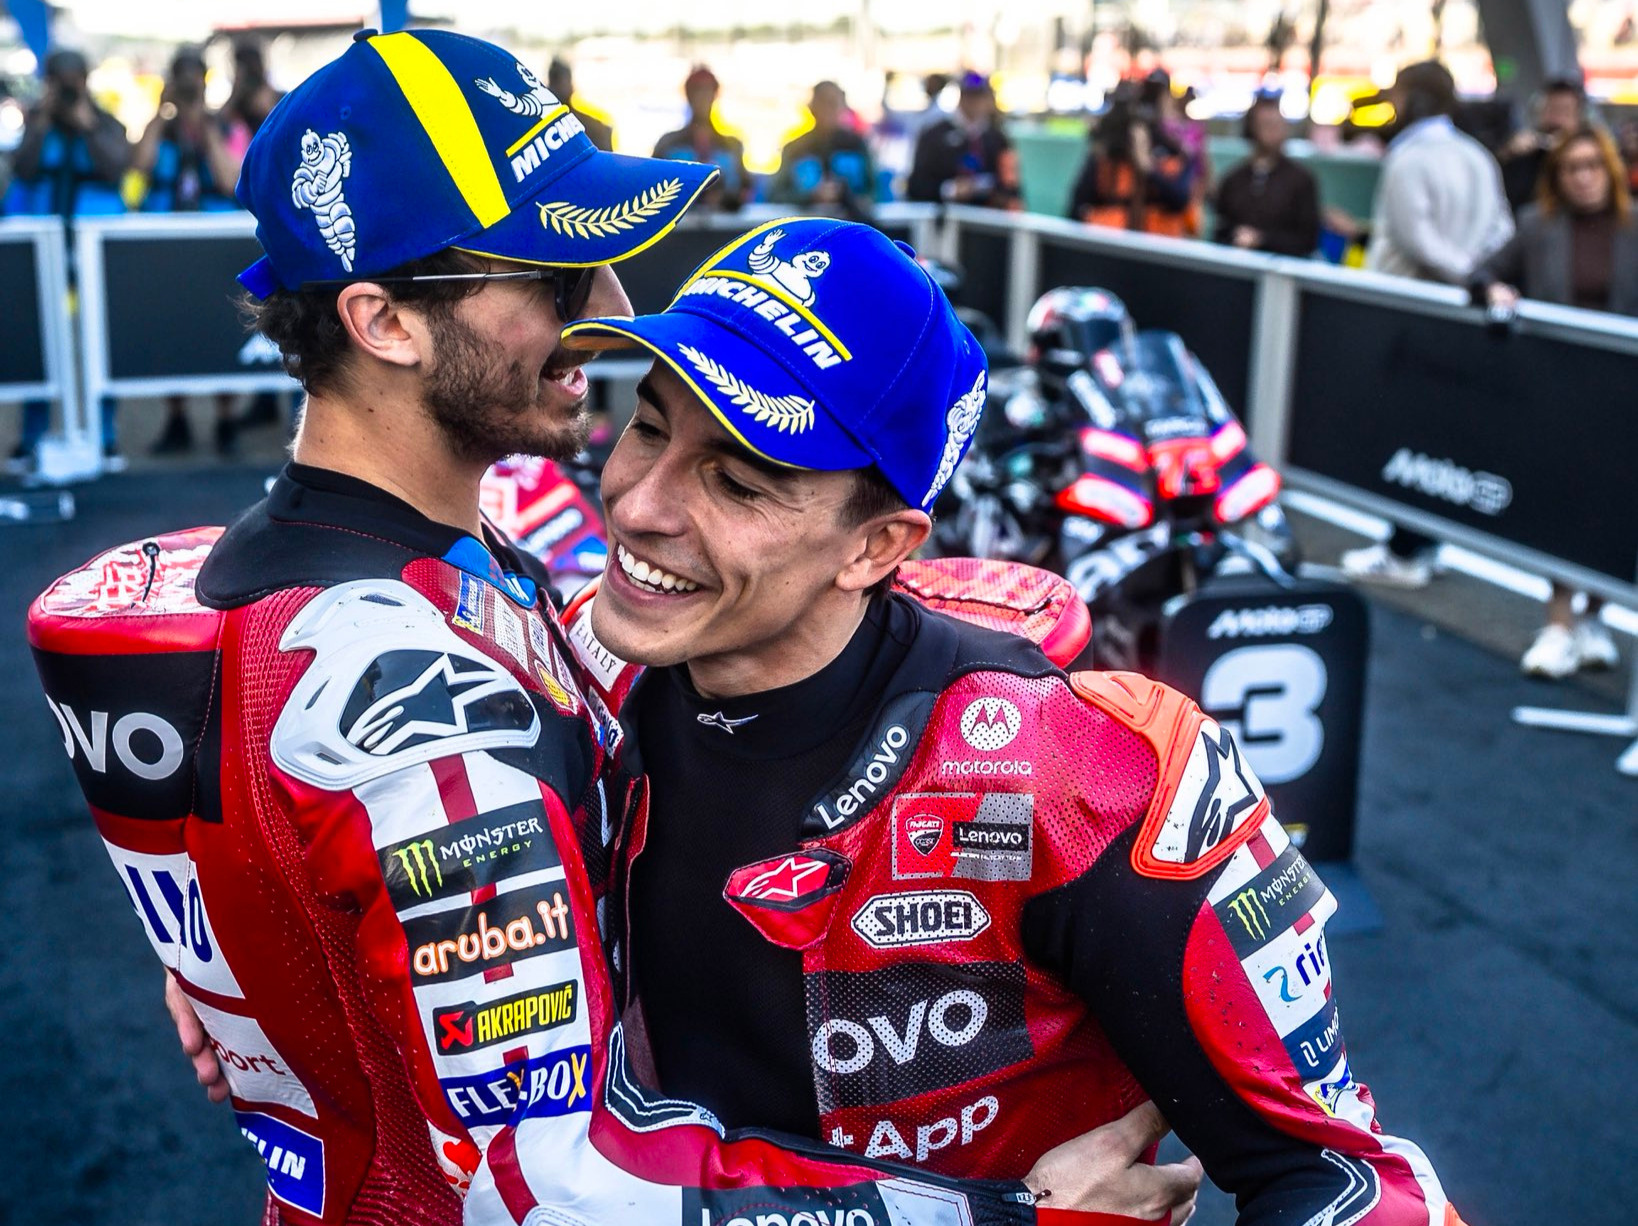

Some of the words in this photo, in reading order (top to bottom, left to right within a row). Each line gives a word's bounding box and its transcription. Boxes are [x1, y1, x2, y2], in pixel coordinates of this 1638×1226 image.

[682, 276, 842, 370] MICHELIN
[1202, 643, 1328, 784] 3
[816, 725, 910, 830] Lenovo
[941, 760, 1032, 776] motorola
[440, 817, 543, 860] MONSTER
[463, 840, 532, 867] ENERGY
[959, 827, 1022, 845] Lenovo
[413, 892, 568, 975] aruba.it
[874, 901, 972, 936] SHOEI
